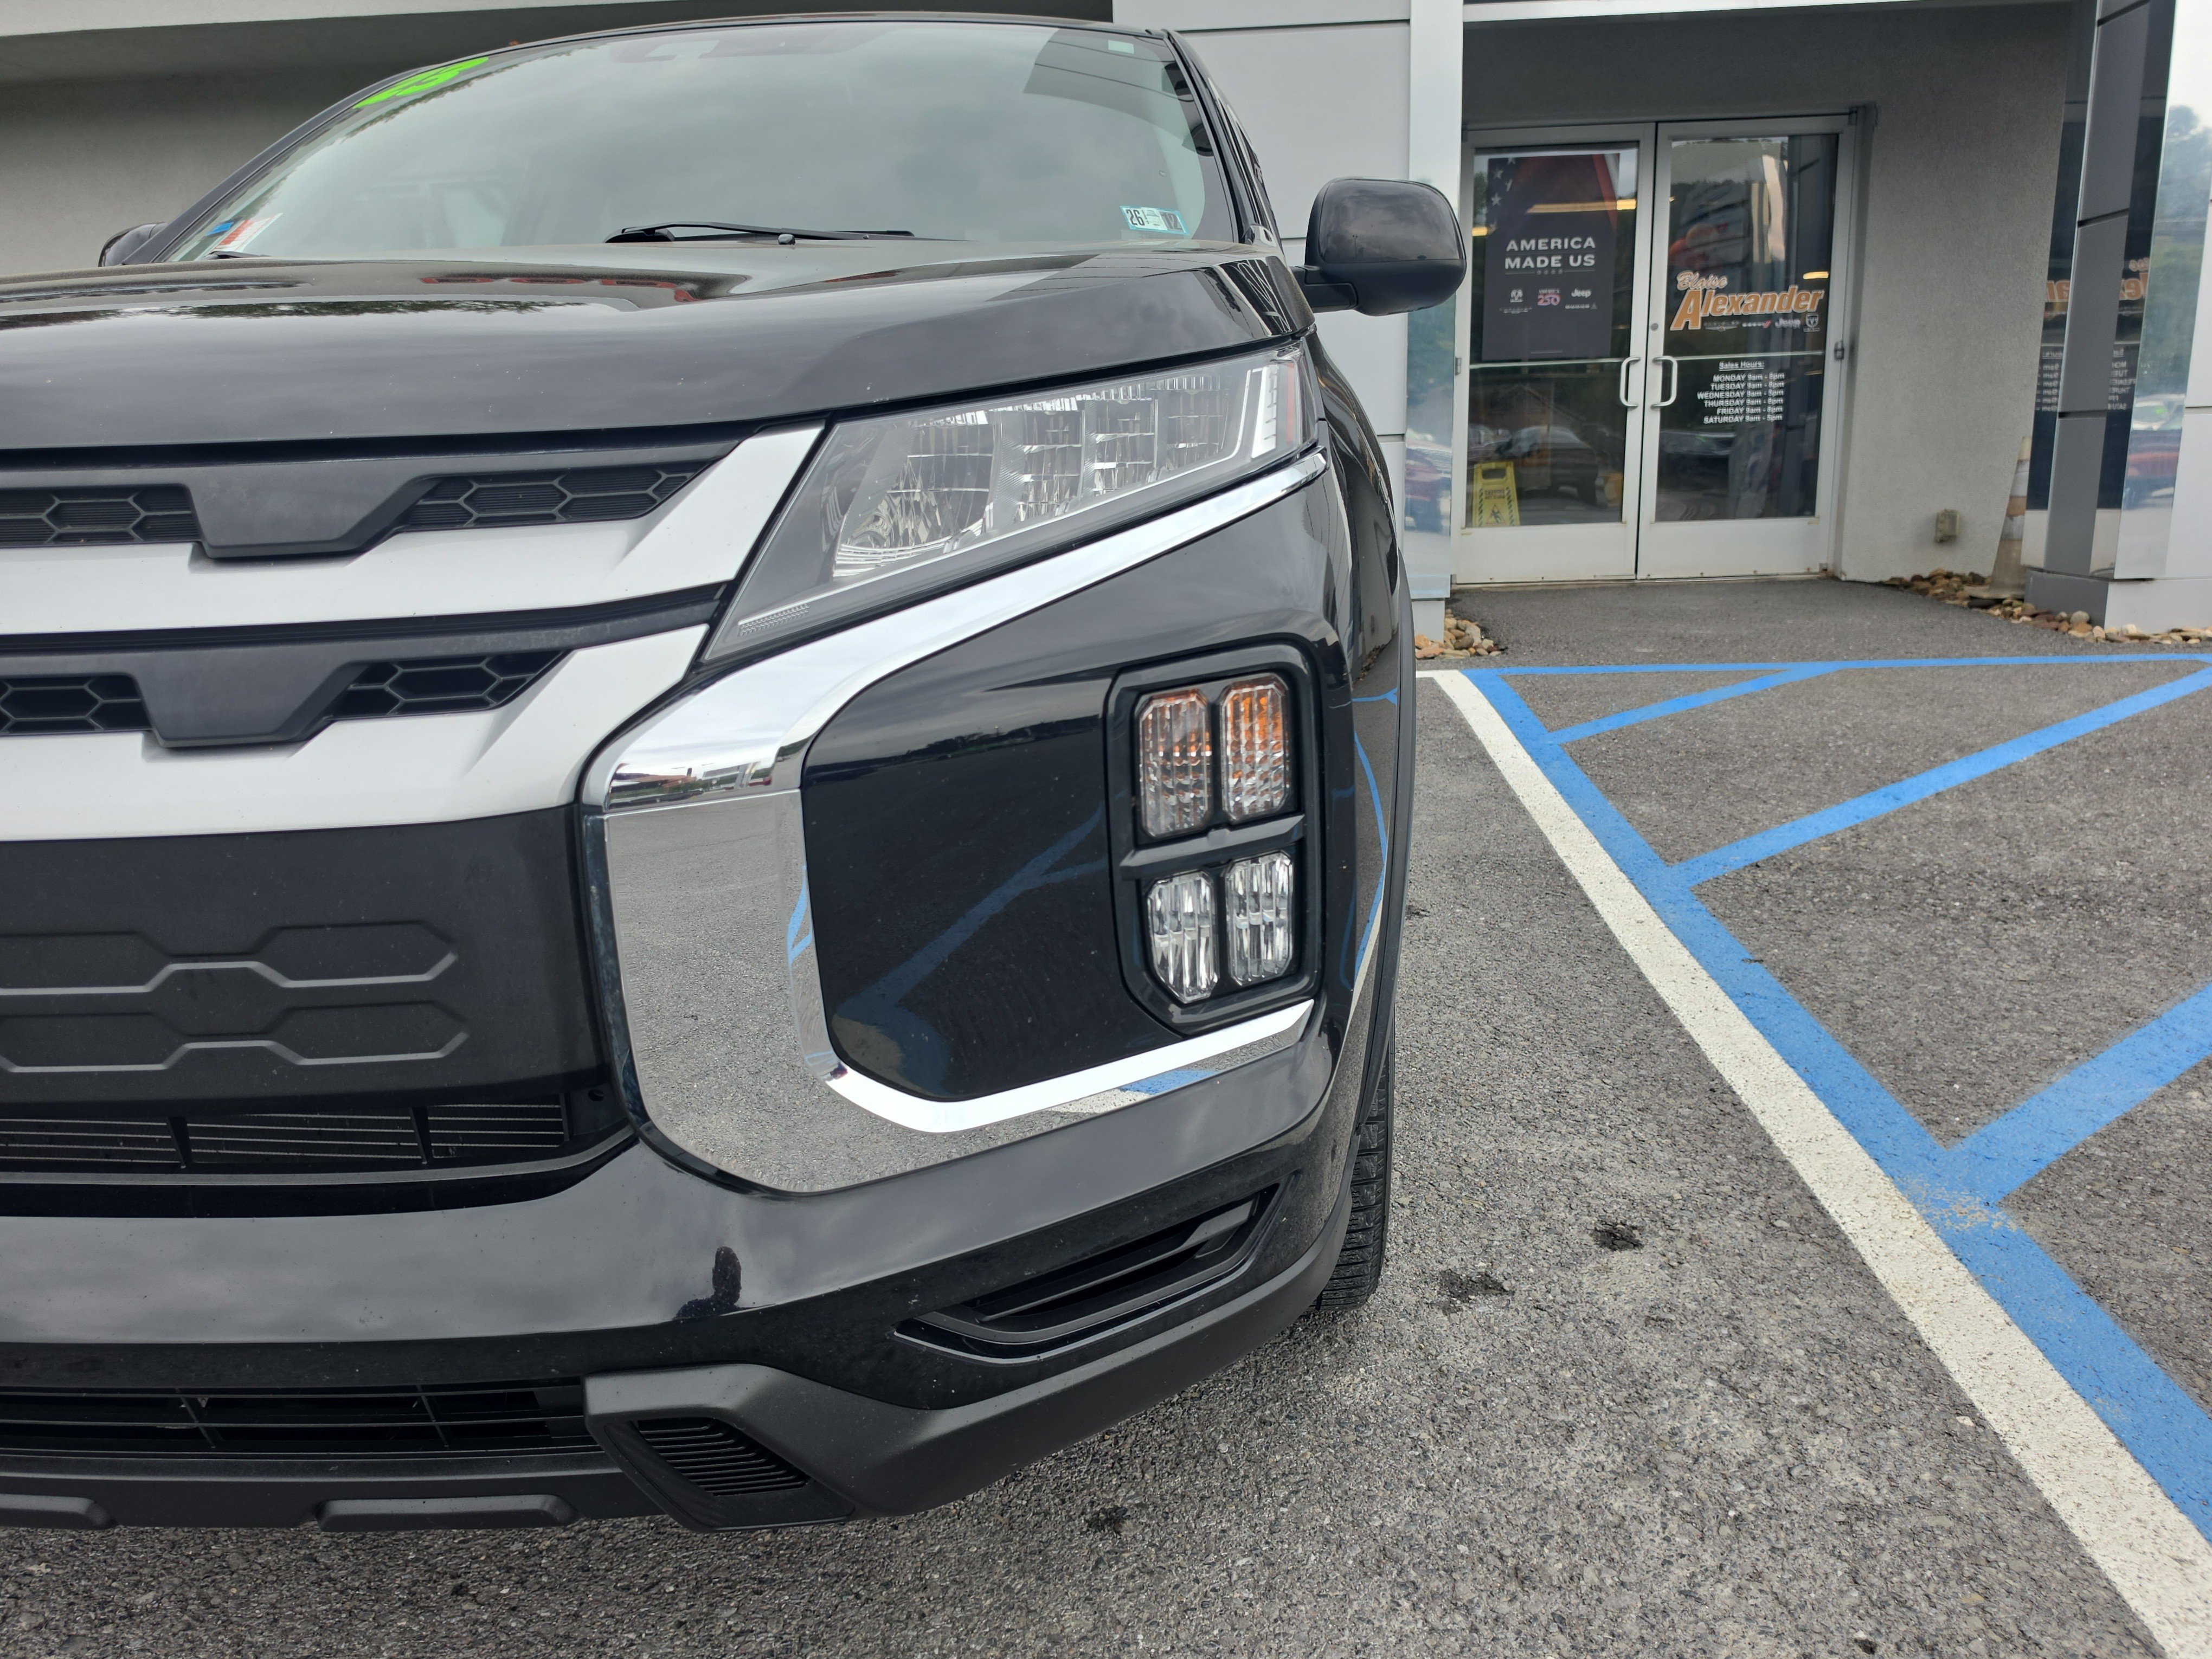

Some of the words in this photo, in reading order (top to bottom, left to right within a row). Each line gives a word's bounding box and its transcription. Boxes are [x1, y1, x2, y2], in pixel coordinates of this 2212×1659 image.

[1126, 209, 1145, 226] 26
[1159, 212, 1184, 230] 12
[1506, 236, 1596, 252] AMERICA
[1505, 255, 1562, 269] MADE
[1569, 254, 1596, 267] US
[1677, 270, 1728, 291] Blaise
[1538, 293, 1561, 306] 250
[1670, 284, 1825, 331] Alexander
[1719, 361, 1739, 370] Sales
[1713, 373, 1746, 382] MONDAY
[1711, 382, 1746, 390] TUESDAY
[1697, 390, 1746, 400] WEDNESDAY
[1703, 398, 1745, 407] THURSDAY
[1716, 407, 1745, 415] FRIDAY
[1703, 415, 1745, 424] SATURDAY
